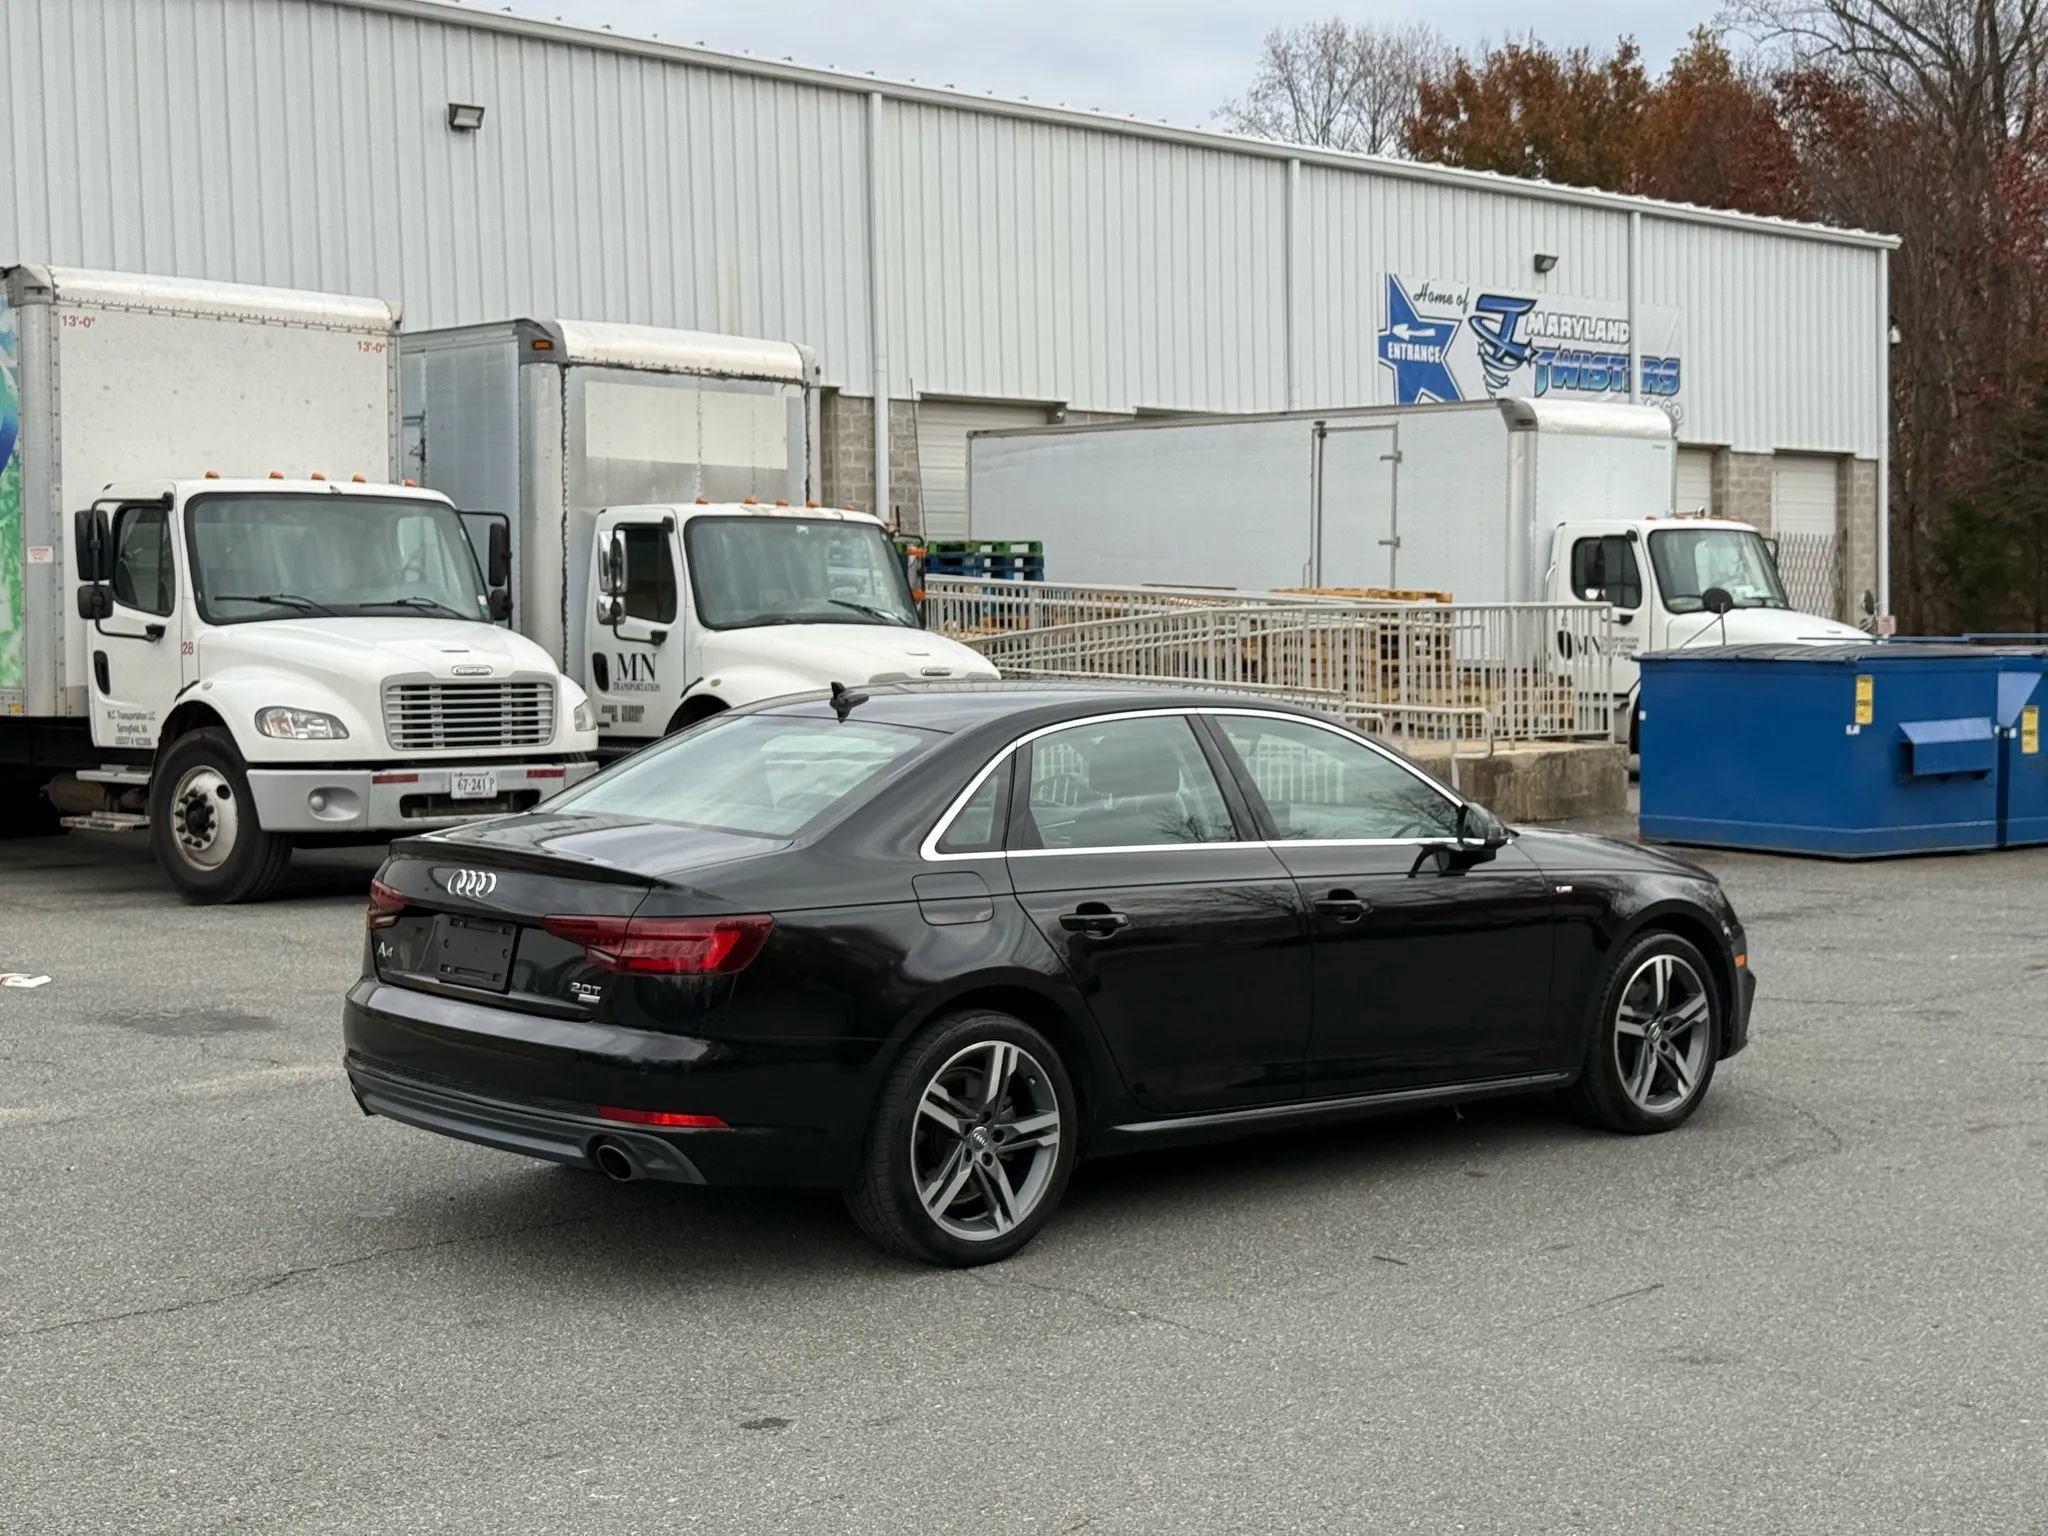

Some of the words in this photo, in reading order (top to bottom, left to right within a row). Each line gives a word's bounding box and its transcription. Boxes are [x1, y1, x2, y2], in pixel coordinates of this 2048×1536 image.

[1413, 281, 1454, 306] Home
[1456, 286, 1470, 315] of
[1525, 311, 1631, 345] MARYLAND
[1387, 341, 1442, 364] ENTRANCE
[182, 641, 194, 655] 28
[616, 652, 657, 681] MN
[377, 941, 394, 958] A4
